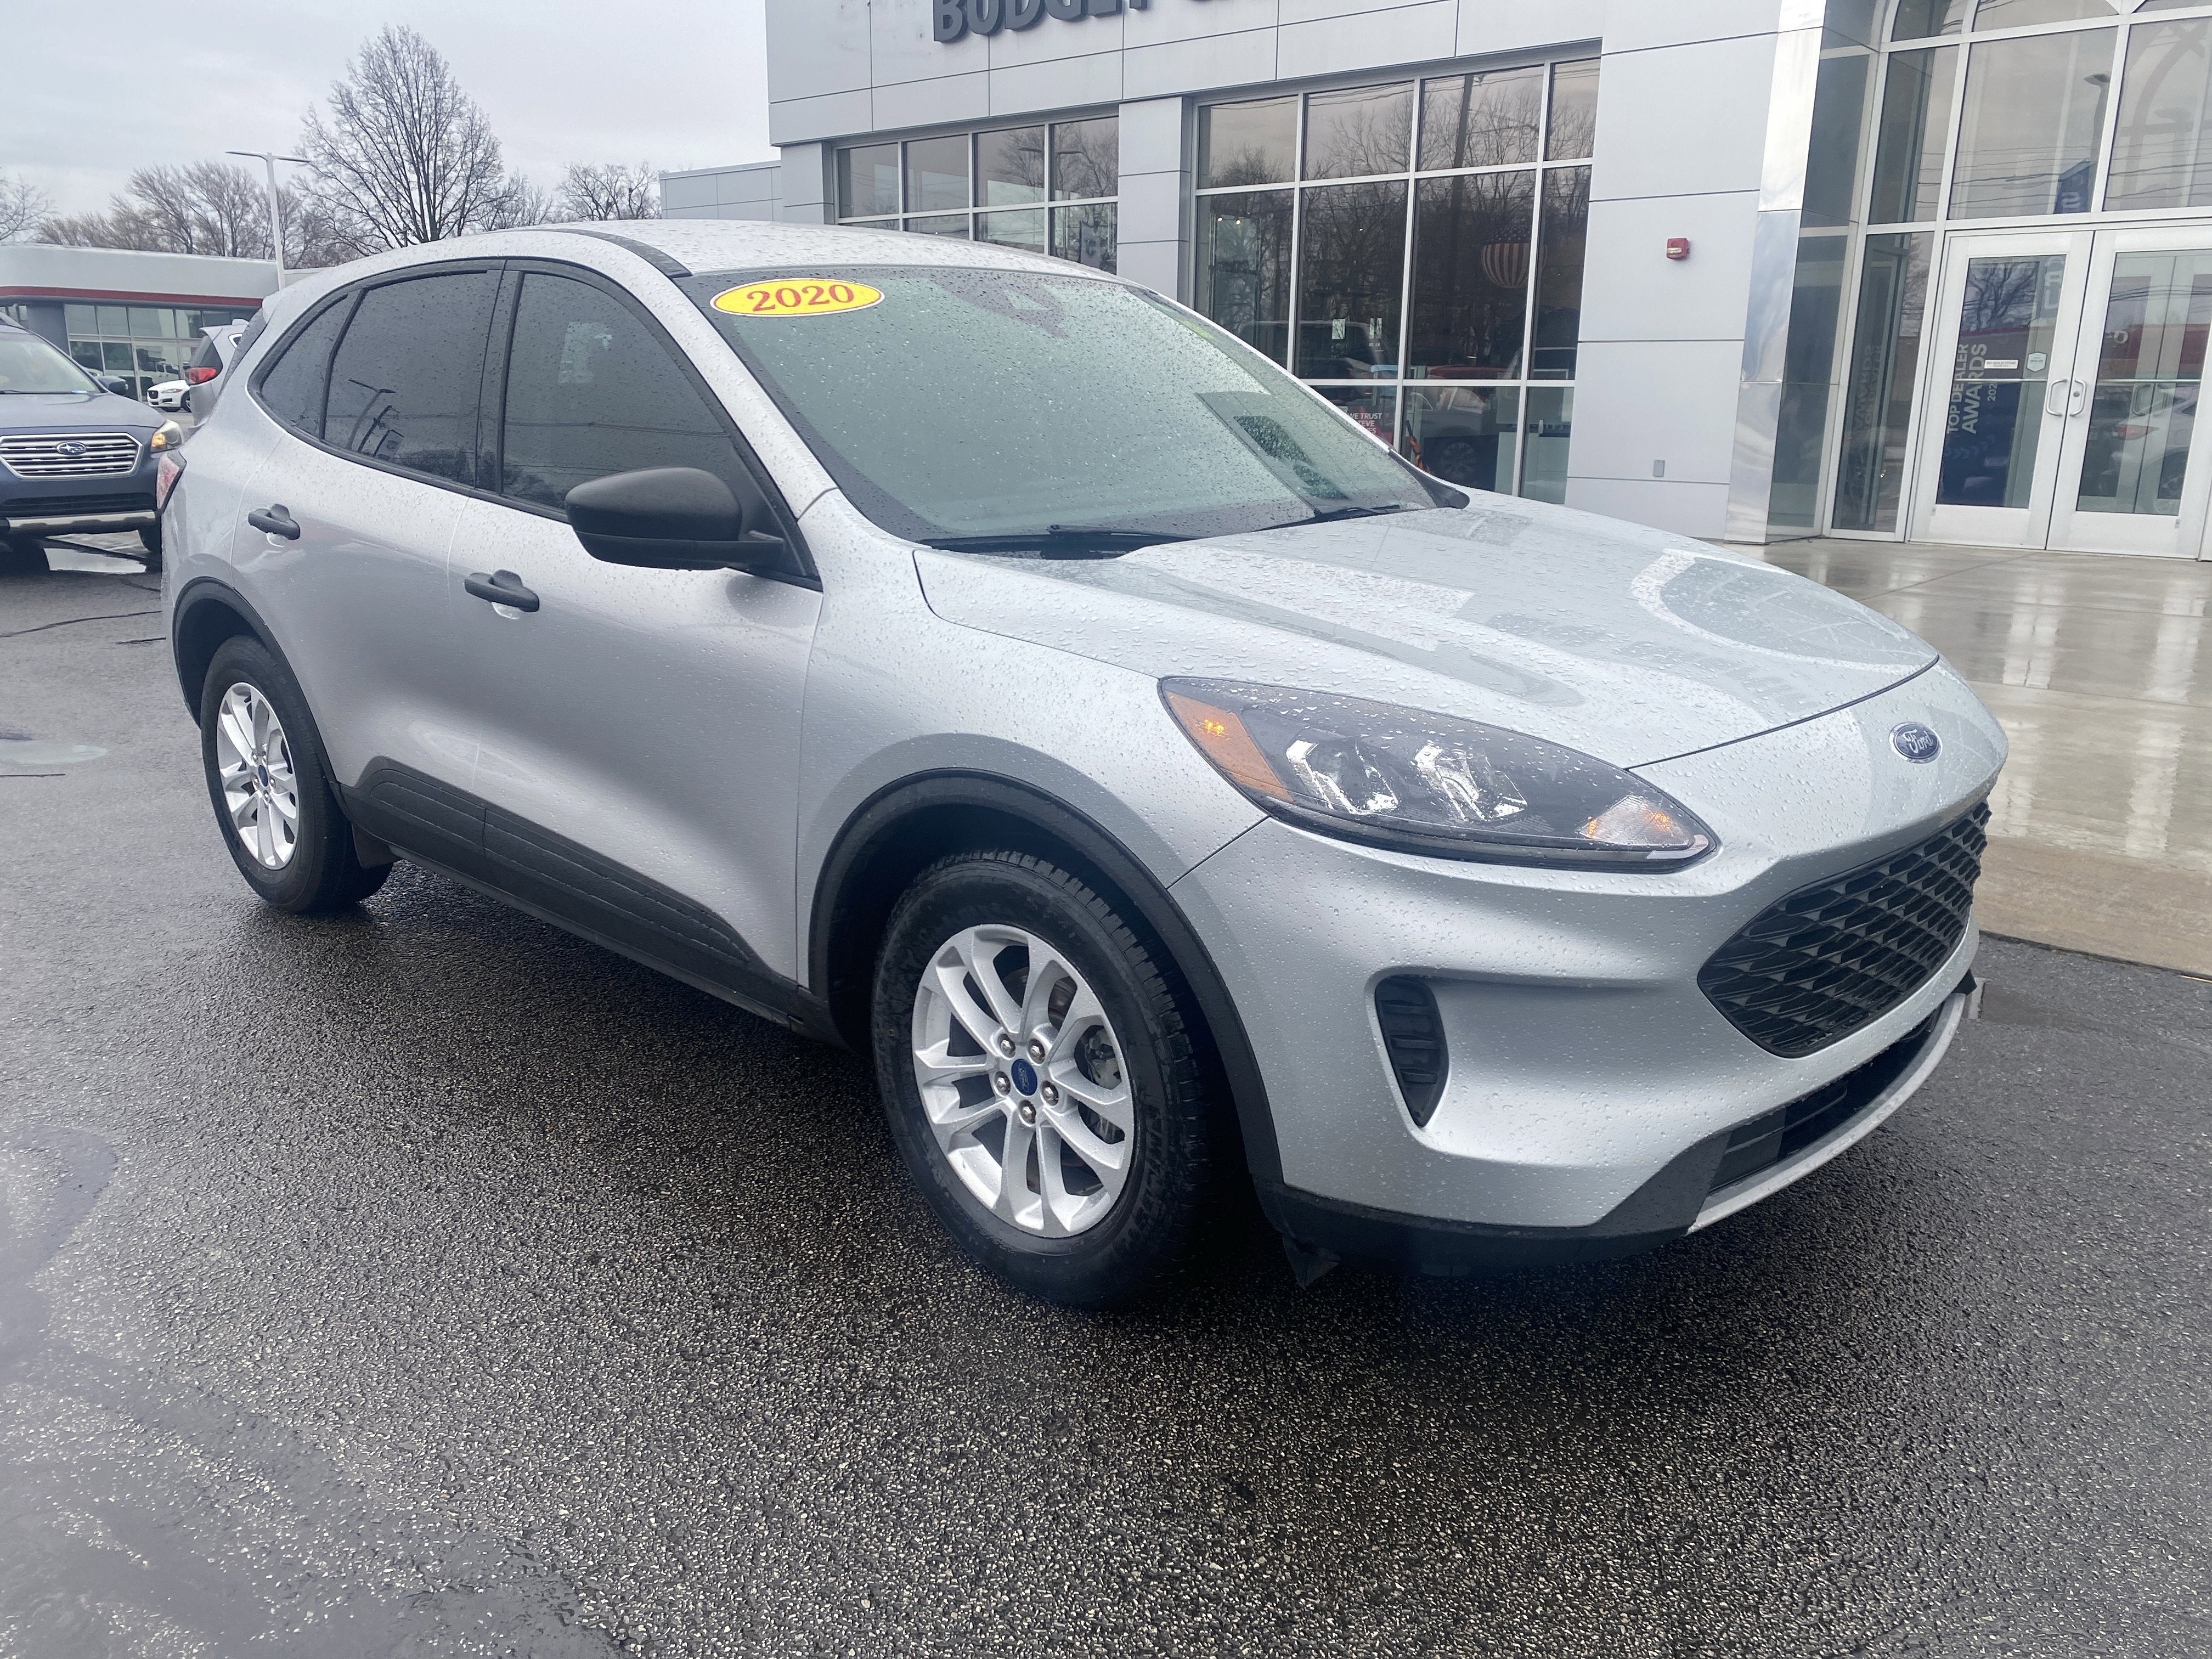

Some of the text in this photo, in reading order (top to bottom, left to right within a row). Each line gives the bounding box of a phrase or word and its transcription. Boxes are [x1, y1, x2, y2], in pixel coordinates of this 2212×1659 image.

[933, 0, 1147, 42] BUD
[747, 284, 854, 312] 2020
[1948, 343, 1969, 434] TOP DEALER
[1962, 343, 1987, 434] AWARDS
[1987, 377, 1998, 402] 202
[1903, 729, 1934, 754] Ford
